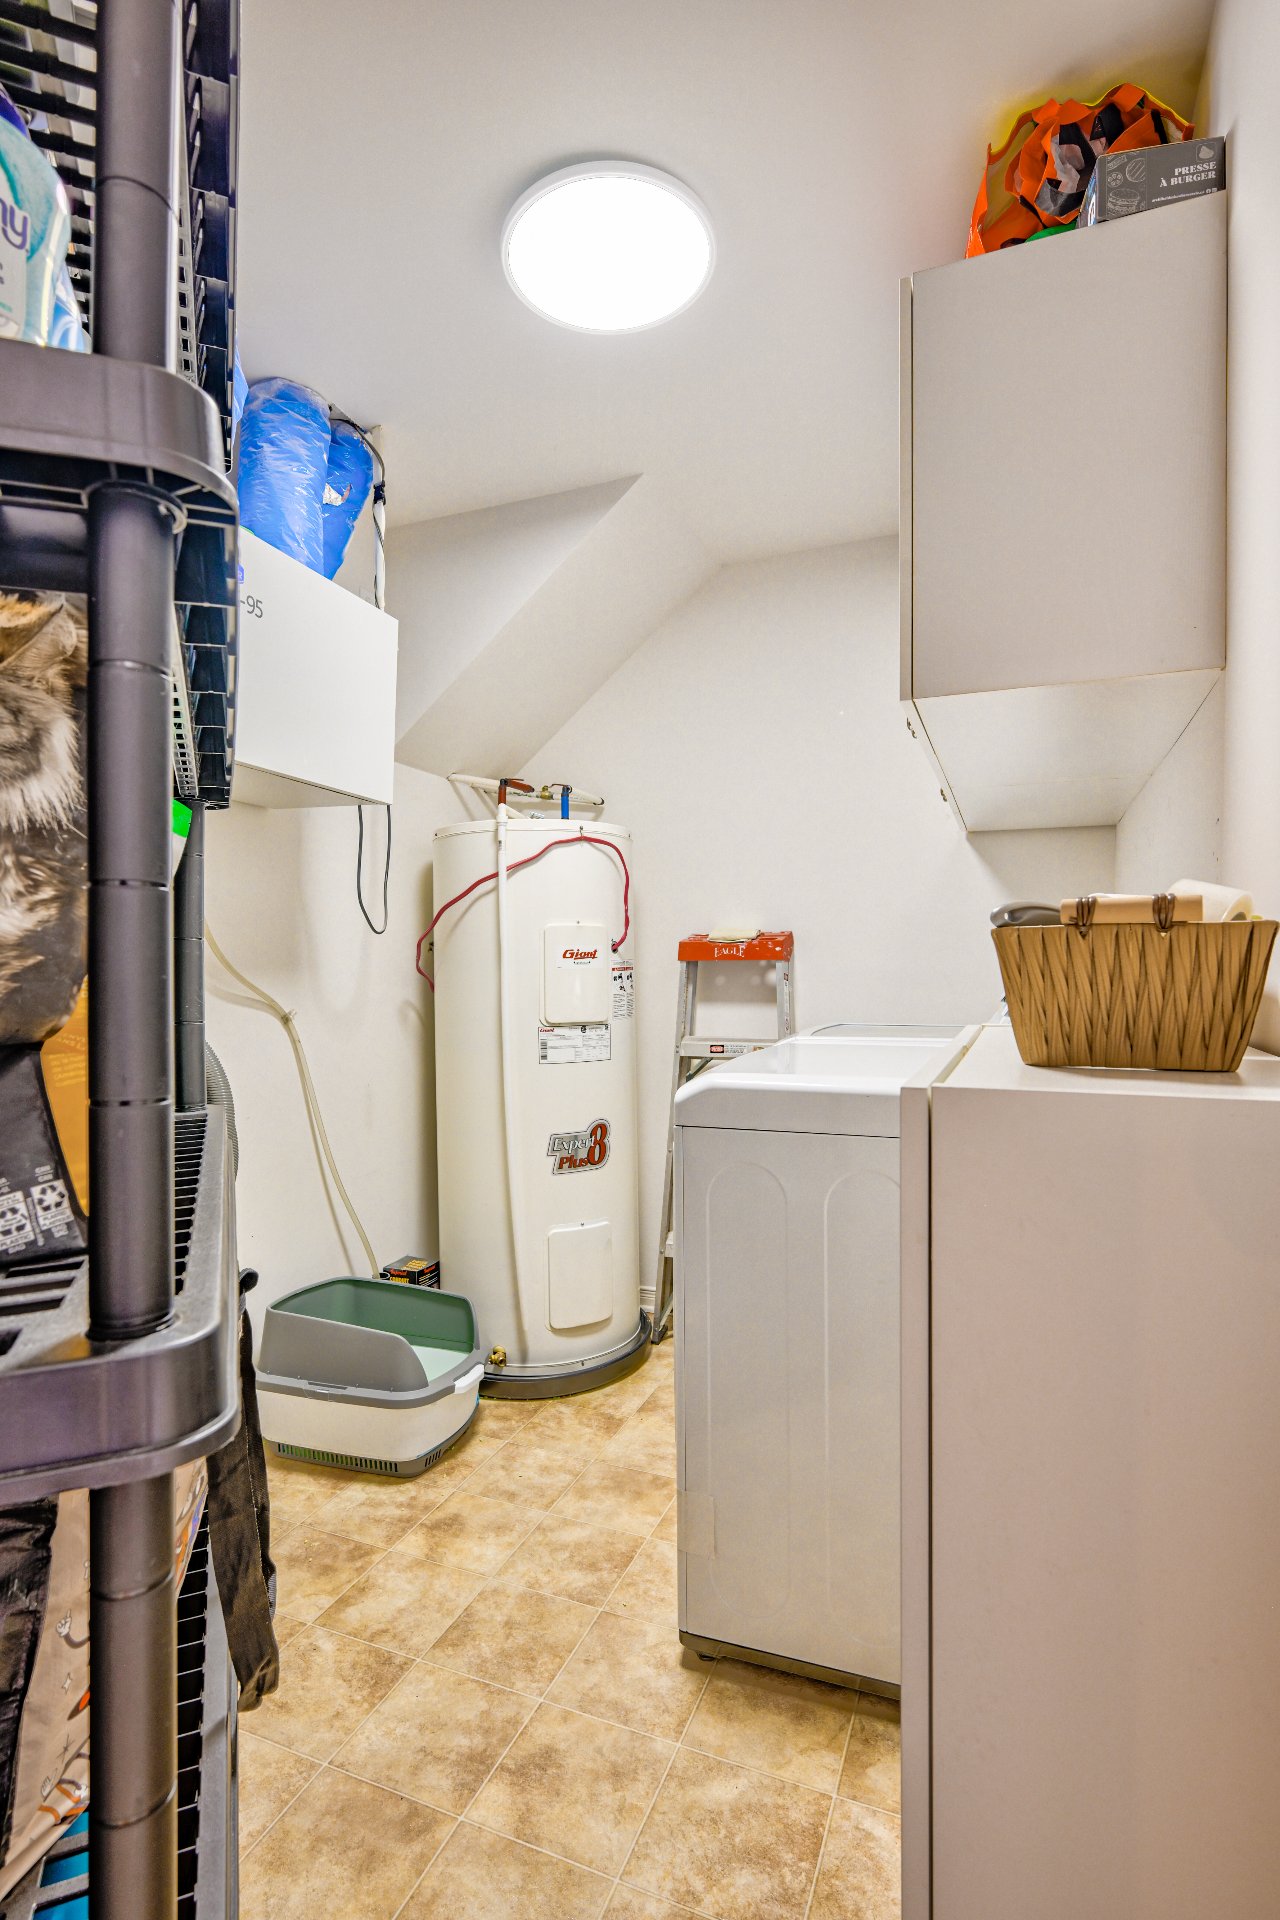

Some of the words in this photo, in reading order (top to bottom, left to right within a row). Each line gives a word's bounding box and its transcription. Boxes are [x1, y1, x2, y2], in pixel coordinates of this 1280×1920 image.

[1174, 162, 1216, 175] PRESSE
[1159, 177, 1168, 188] À
[1171, 171, 1216, 185] BURGER
[562, 948, 599, 961] Giant
[714, 944, 746, 958] EAGLE
[552, 1135, 595, 1155] Expert
[587, 1123, 608, 1166] 8
[557, 1154, 589, 1170] Plus
